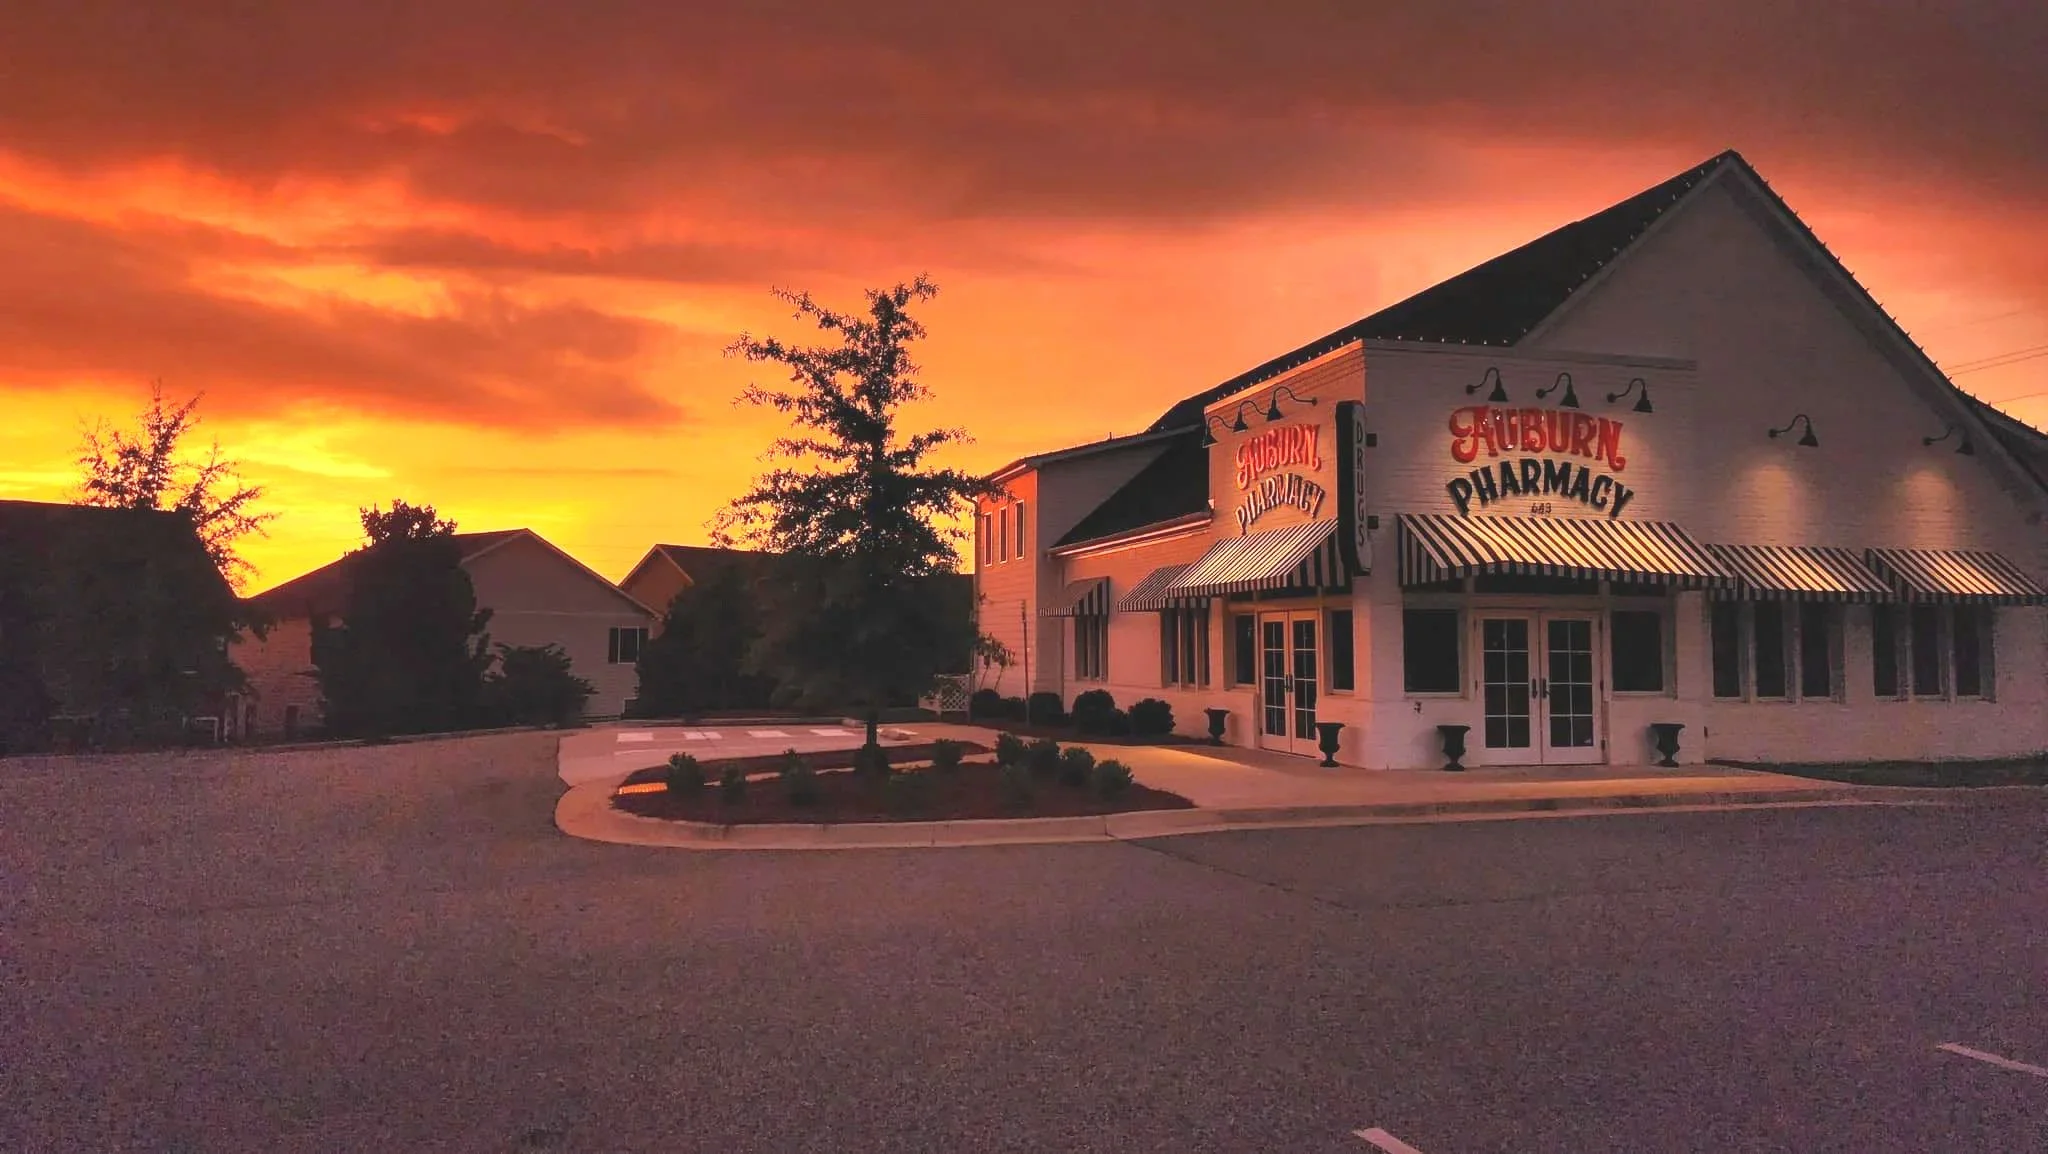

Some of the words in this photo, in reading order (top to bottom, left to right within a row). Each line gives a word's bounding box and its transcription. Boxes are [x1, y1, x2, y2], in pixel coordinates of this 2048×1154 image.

[1235, 424, 1321, 490] AUBURN
[1449, 405, 1626, 471] AUBURN
[1234, 473, 1325, 535] PHARMACY
[1356, 422, 1365, 546] DRUGS
[1447, 458, 1634, 519] PHARMACY
